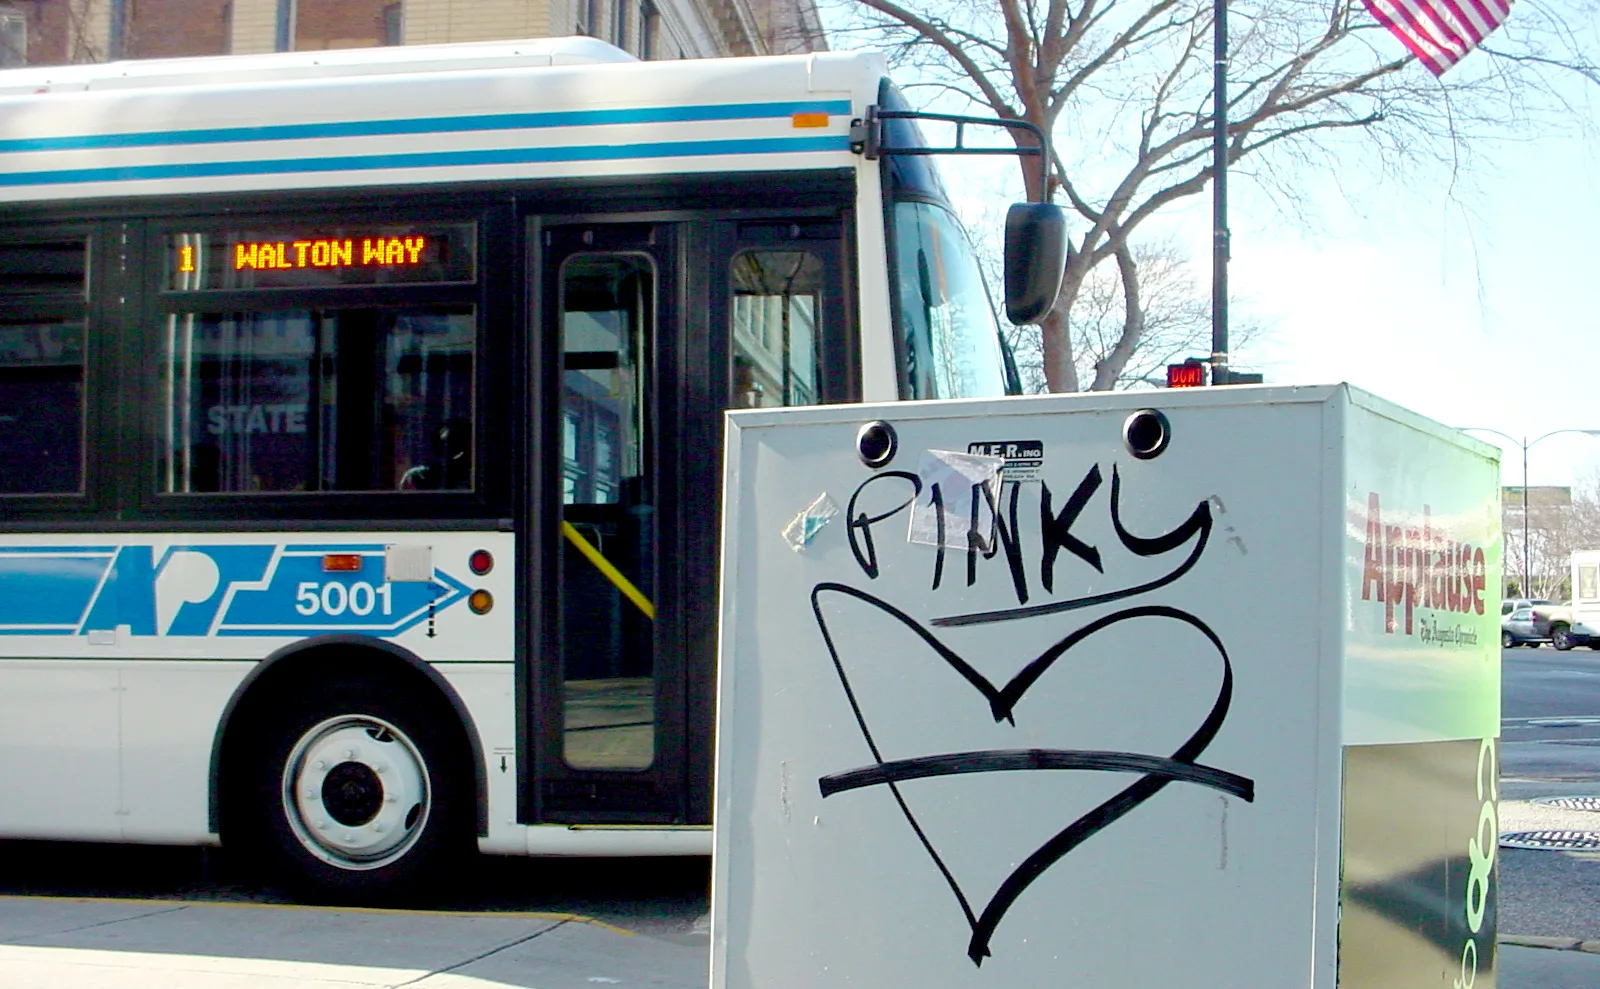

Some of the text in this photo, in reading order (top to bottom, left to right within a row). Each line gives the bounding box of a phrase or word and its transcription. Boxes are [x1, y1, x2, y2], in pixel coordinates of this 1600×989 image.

[181, 236, 424, 271] 1 WALTON WAY
[207, 403, 309, 434] STATE
[846, 462, 1213, 626] PINKY
[1361, 491, 1486, 635] Applause
[295, 581, 392, 616] 5001
